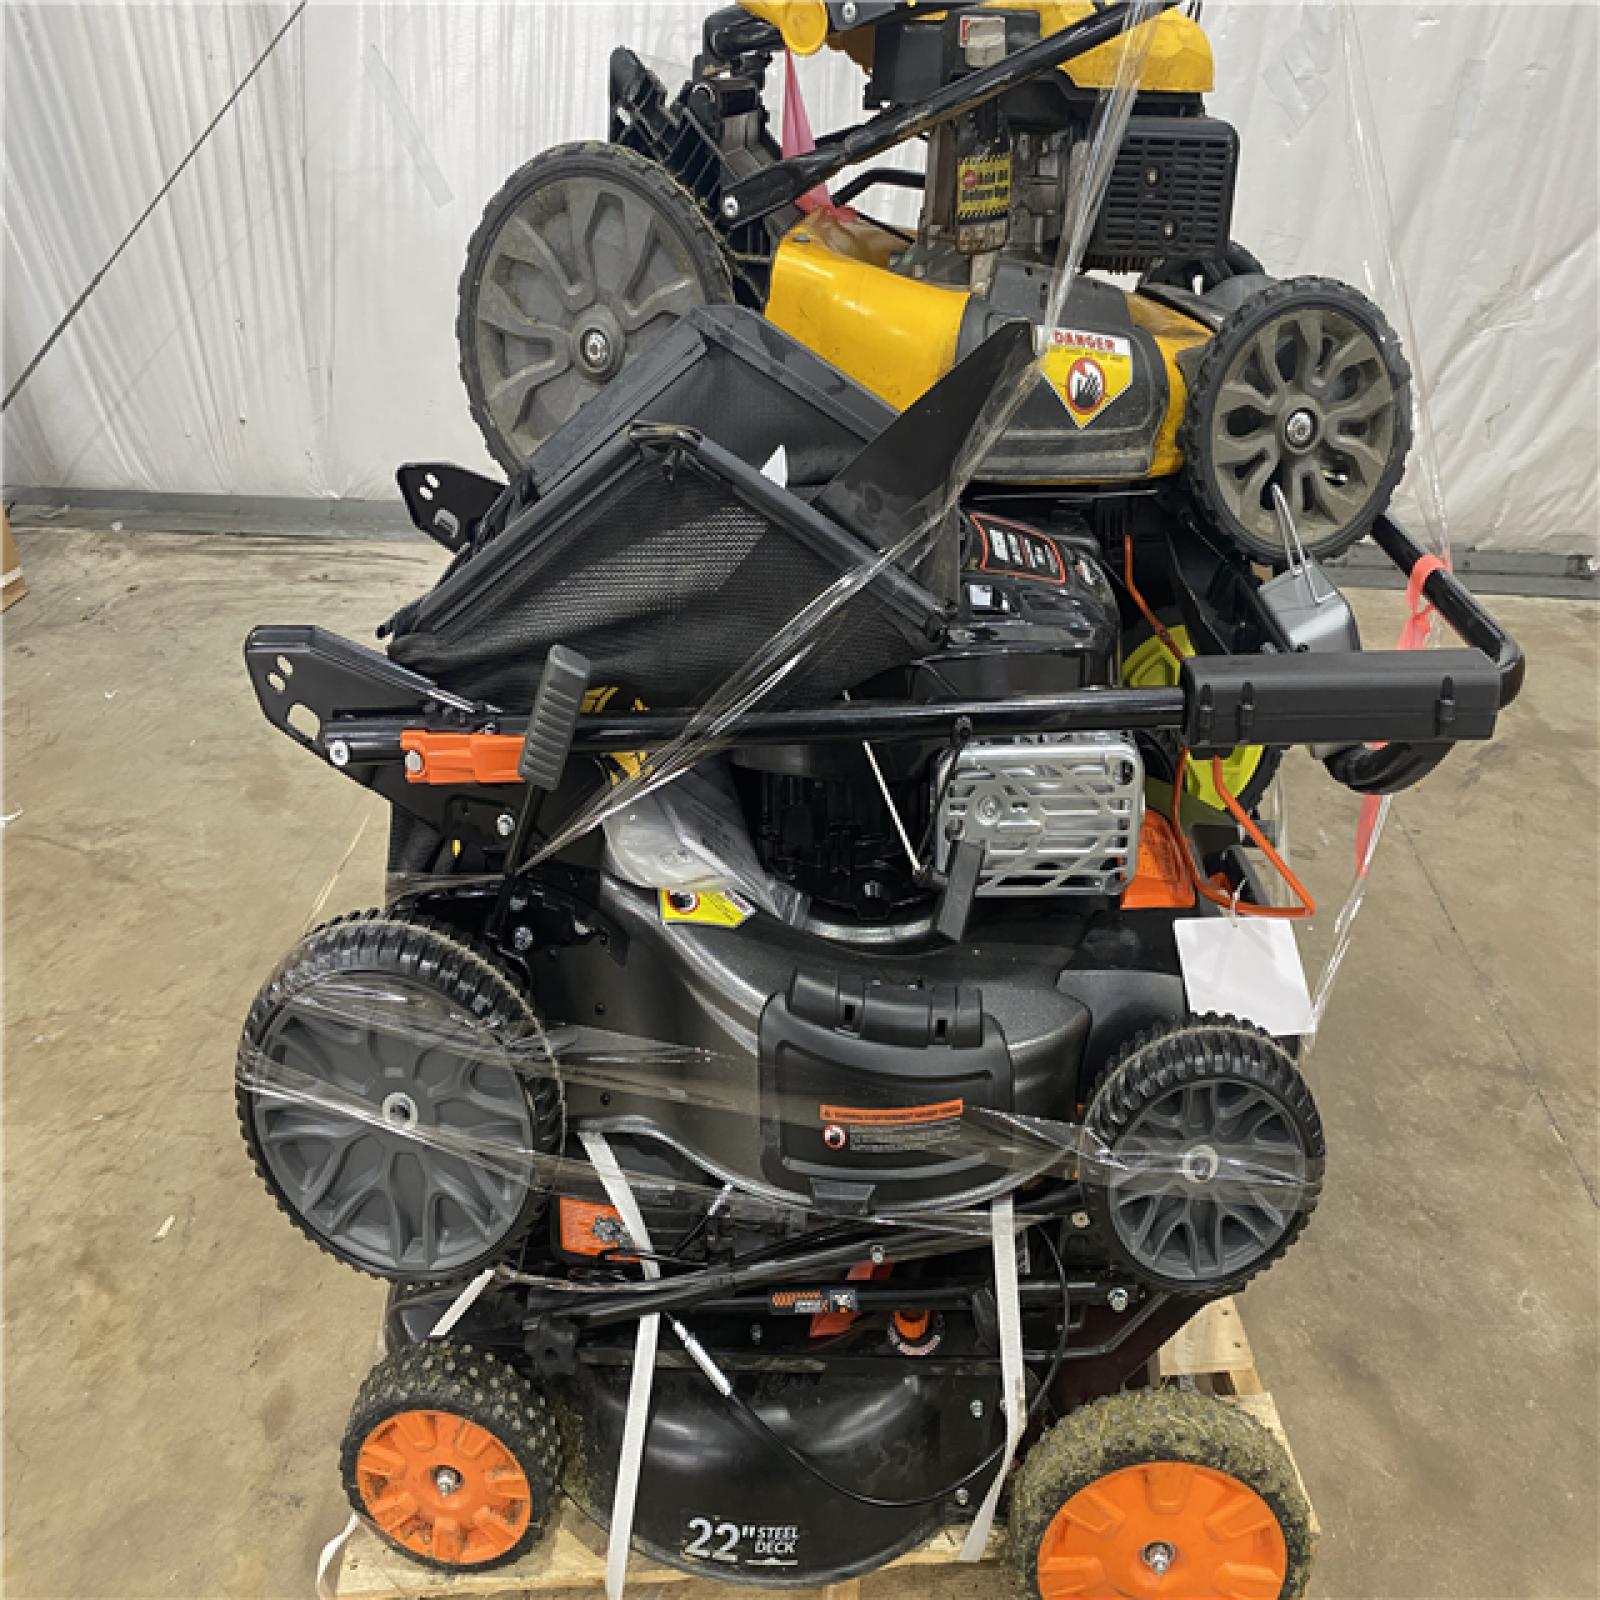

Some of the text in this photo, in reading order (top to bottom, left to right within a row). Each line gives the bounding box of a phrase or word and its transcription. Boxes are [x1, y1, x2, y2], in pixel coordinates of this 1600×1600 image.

[1054, 330, 1115, 351] DANGER
[685, 1517, 800, 1561] 22" STEEL
[755, 1540, 796, 1553] DECK
